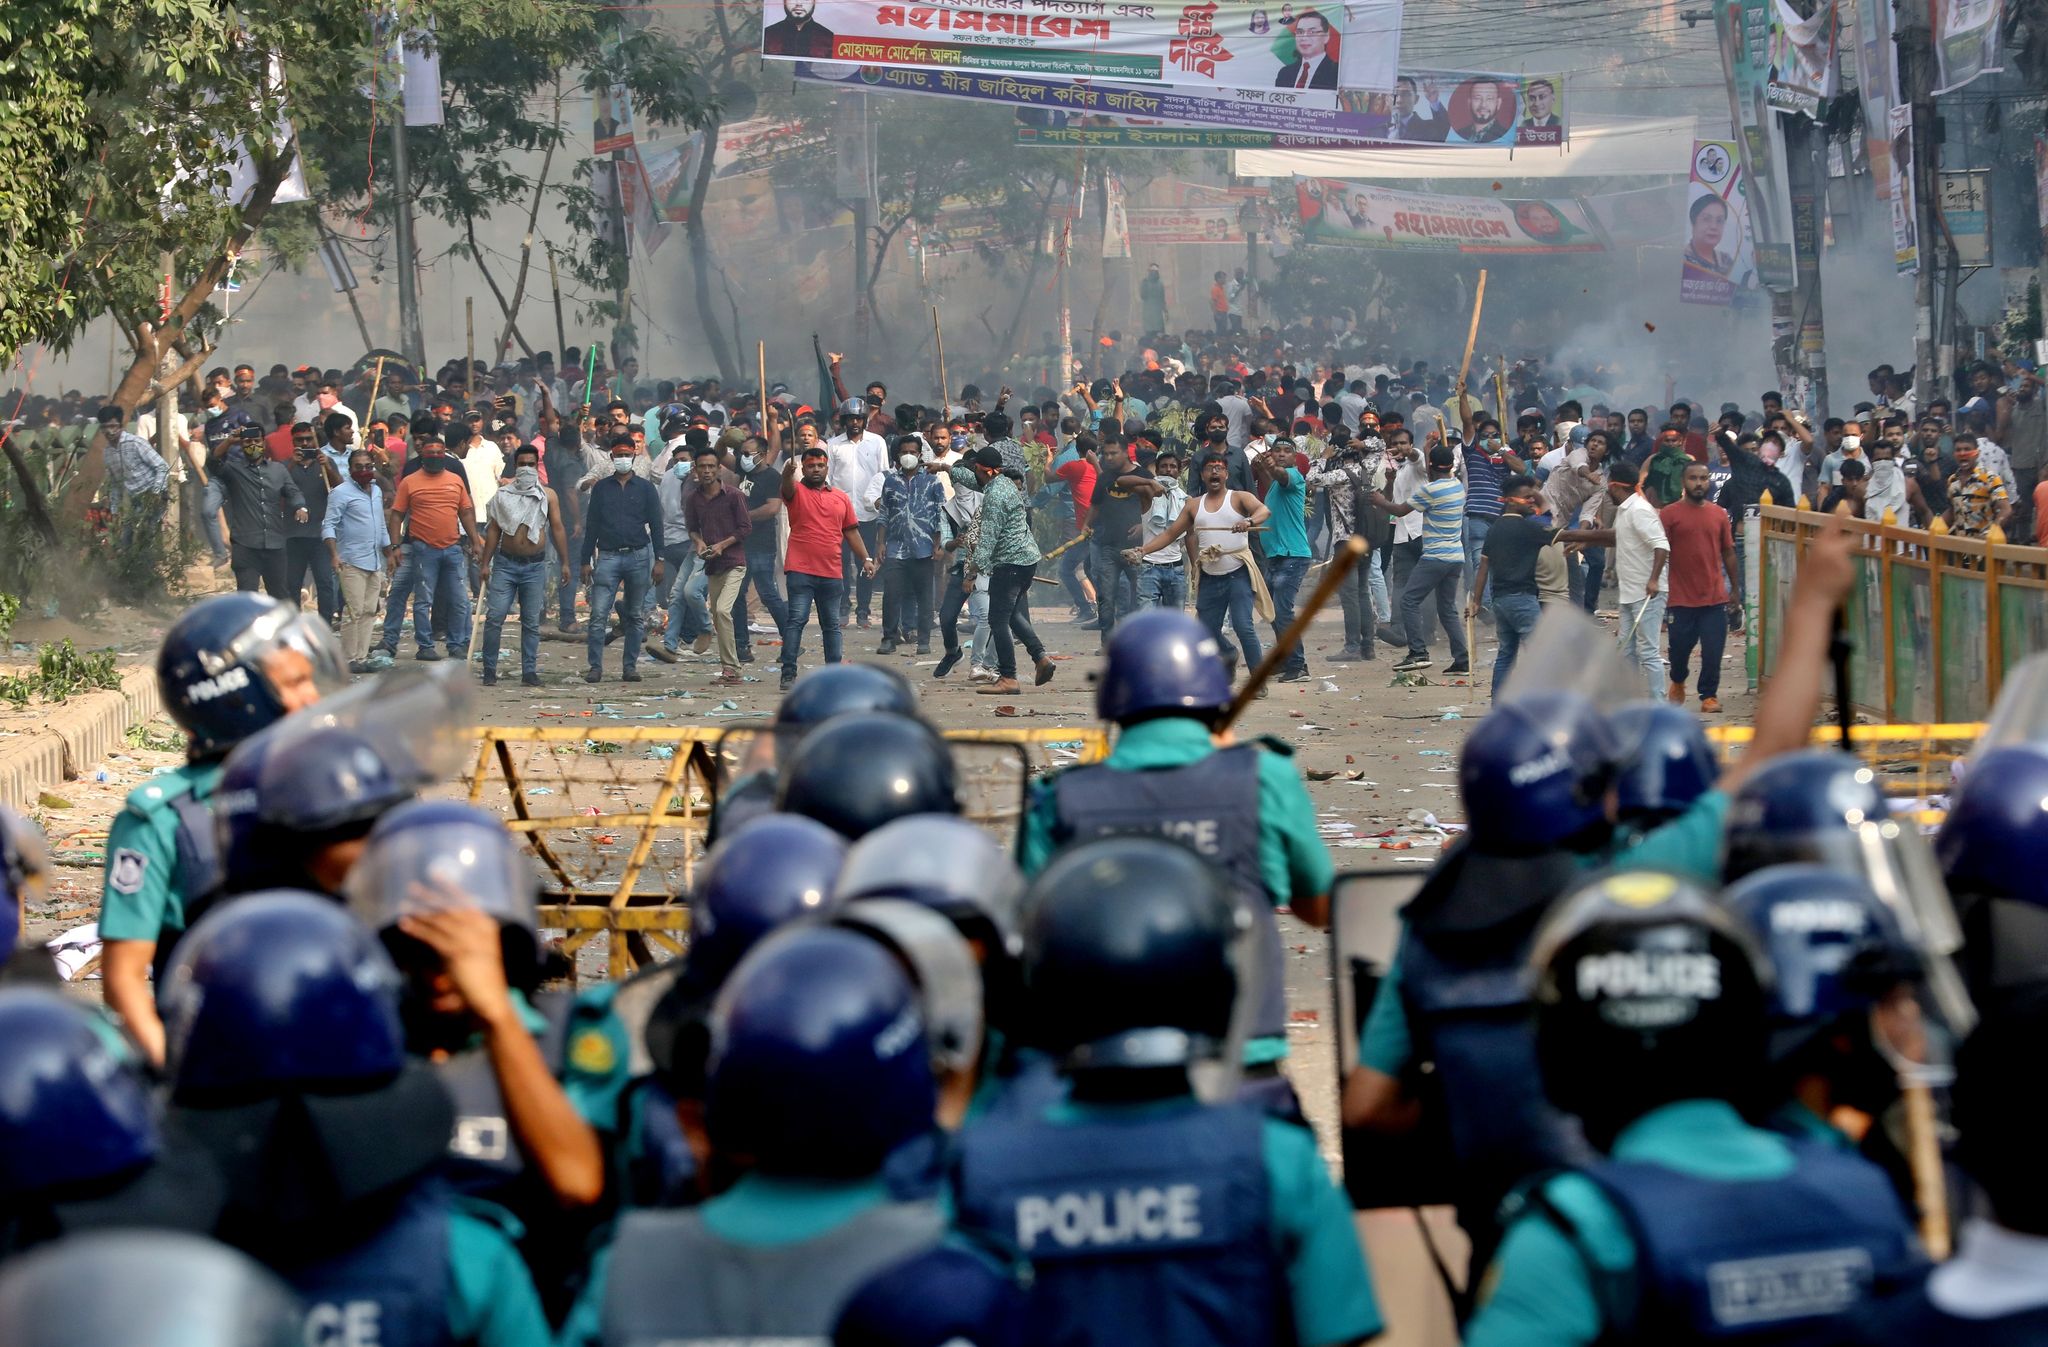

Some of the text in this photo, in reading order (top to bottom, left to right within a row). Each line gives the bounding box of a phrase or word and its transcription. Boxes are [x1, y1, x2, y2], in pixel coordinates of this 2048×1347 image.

[1032, 0, 1105, 15] পদত্যাগ
[1113, 4, 1156, 20] এবং
[876, 5, 1110, 40] মহাসমাবেশ
[953, 34, 972, 42] সফল
[838, 42, 962, 65] মোহাম্মদ মোর্শেদ আলম
[940, 70, 972, 91] মীর
[977, 74, 1047, 100] জাহিদুল
[1053, 82, 1099, 106] কবির
[1105, 90, 1160, 112] জাহিদ
[1236, 88, 1297, 105] সফল হোক
[1164, 95, 1190, 105] সদস্য
[1224, 101, 1258, 112] বরিশাল
[1261, 106, 1298, 116] মহানগর
[1301, 108, 1336, 119] বিএনপি
[1043, 128, 1120, 145] সাইফুল
[1127, 129, 1200, 144] ইসলাম
[1525, 129, 1557, 141] উত্তর
[1393, 211, 1512, 238] মহাসমাবেশ
[187, 667, 249, 704] POLICE
[1575, 952, 1721, 1001] POLICE
[1016, 1184, 1203, 1250] POLICE
